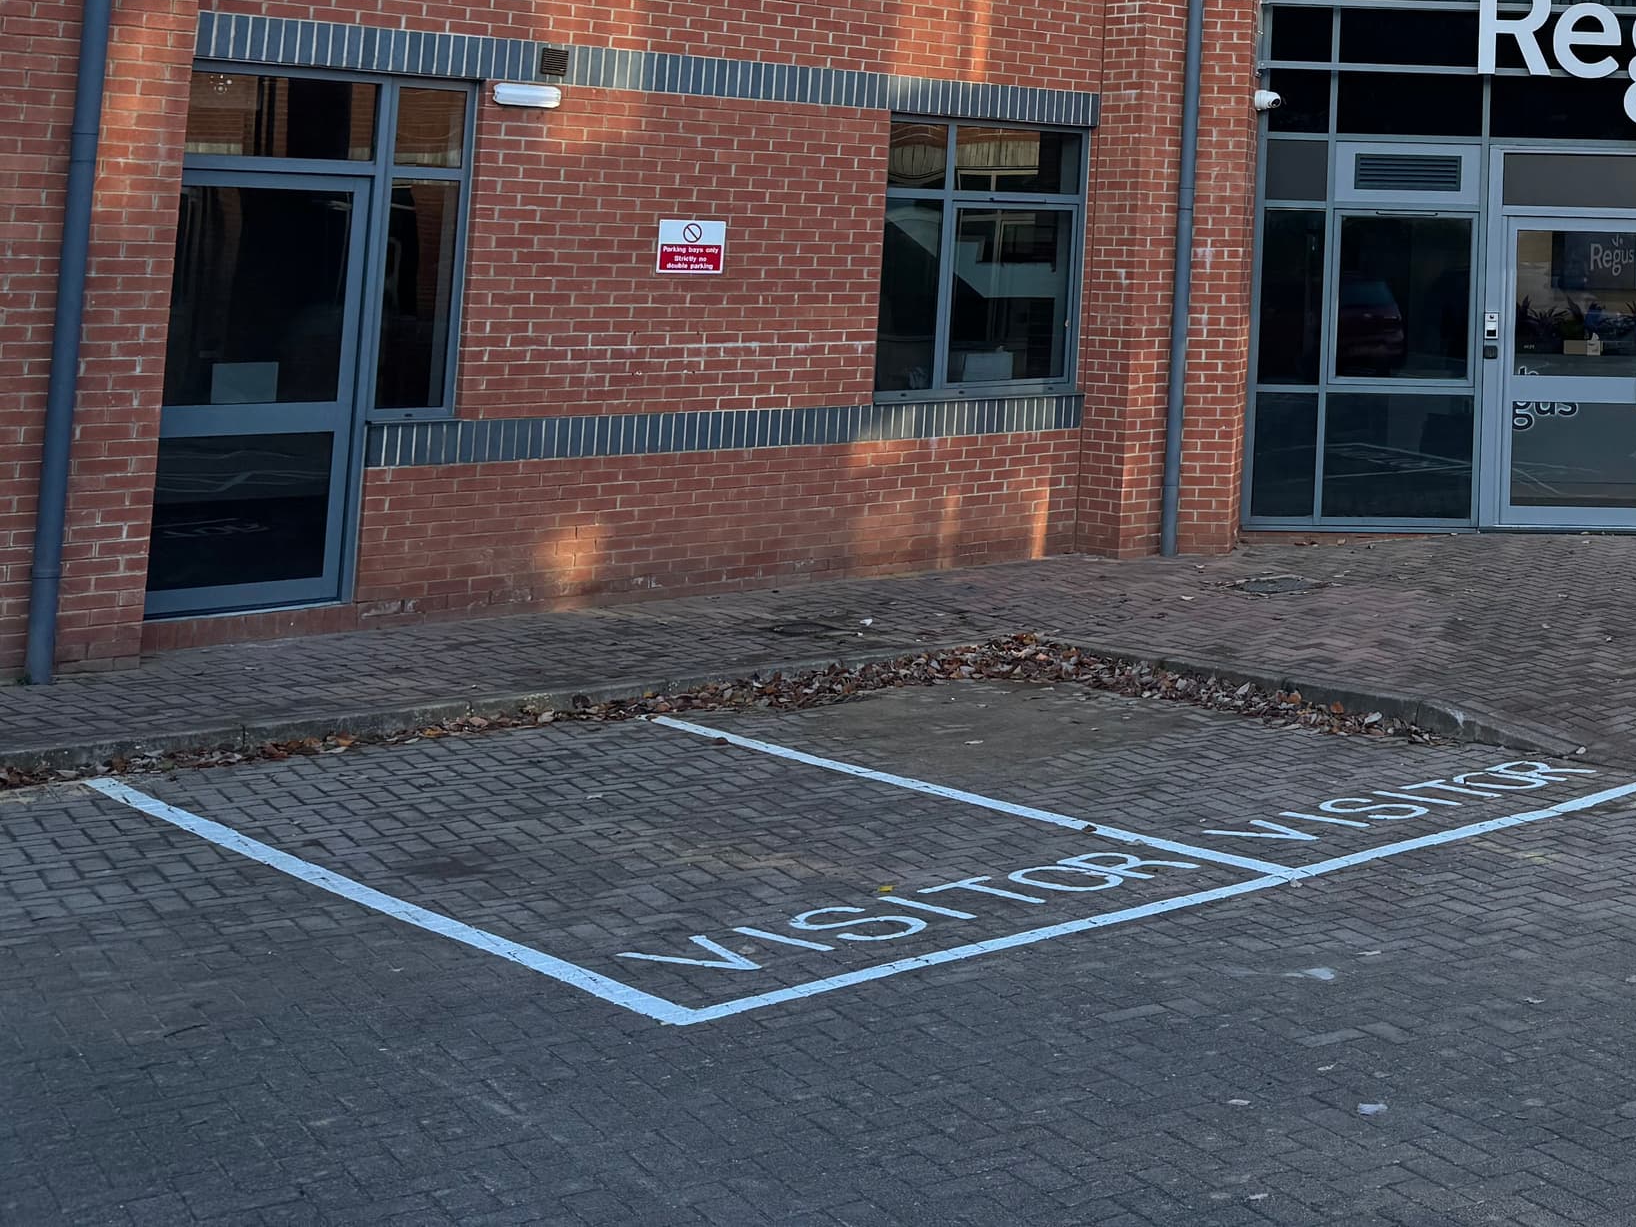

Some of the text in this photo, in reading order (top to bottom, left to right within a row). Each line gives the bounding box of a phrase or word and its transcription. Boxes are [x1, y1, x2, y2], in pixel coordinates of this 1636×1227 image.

[1590, 243, 1635, 276] Regus
[1202, 760, 1597, 841] VISITOR
[616, 852, 1201, 970] VISITOR
